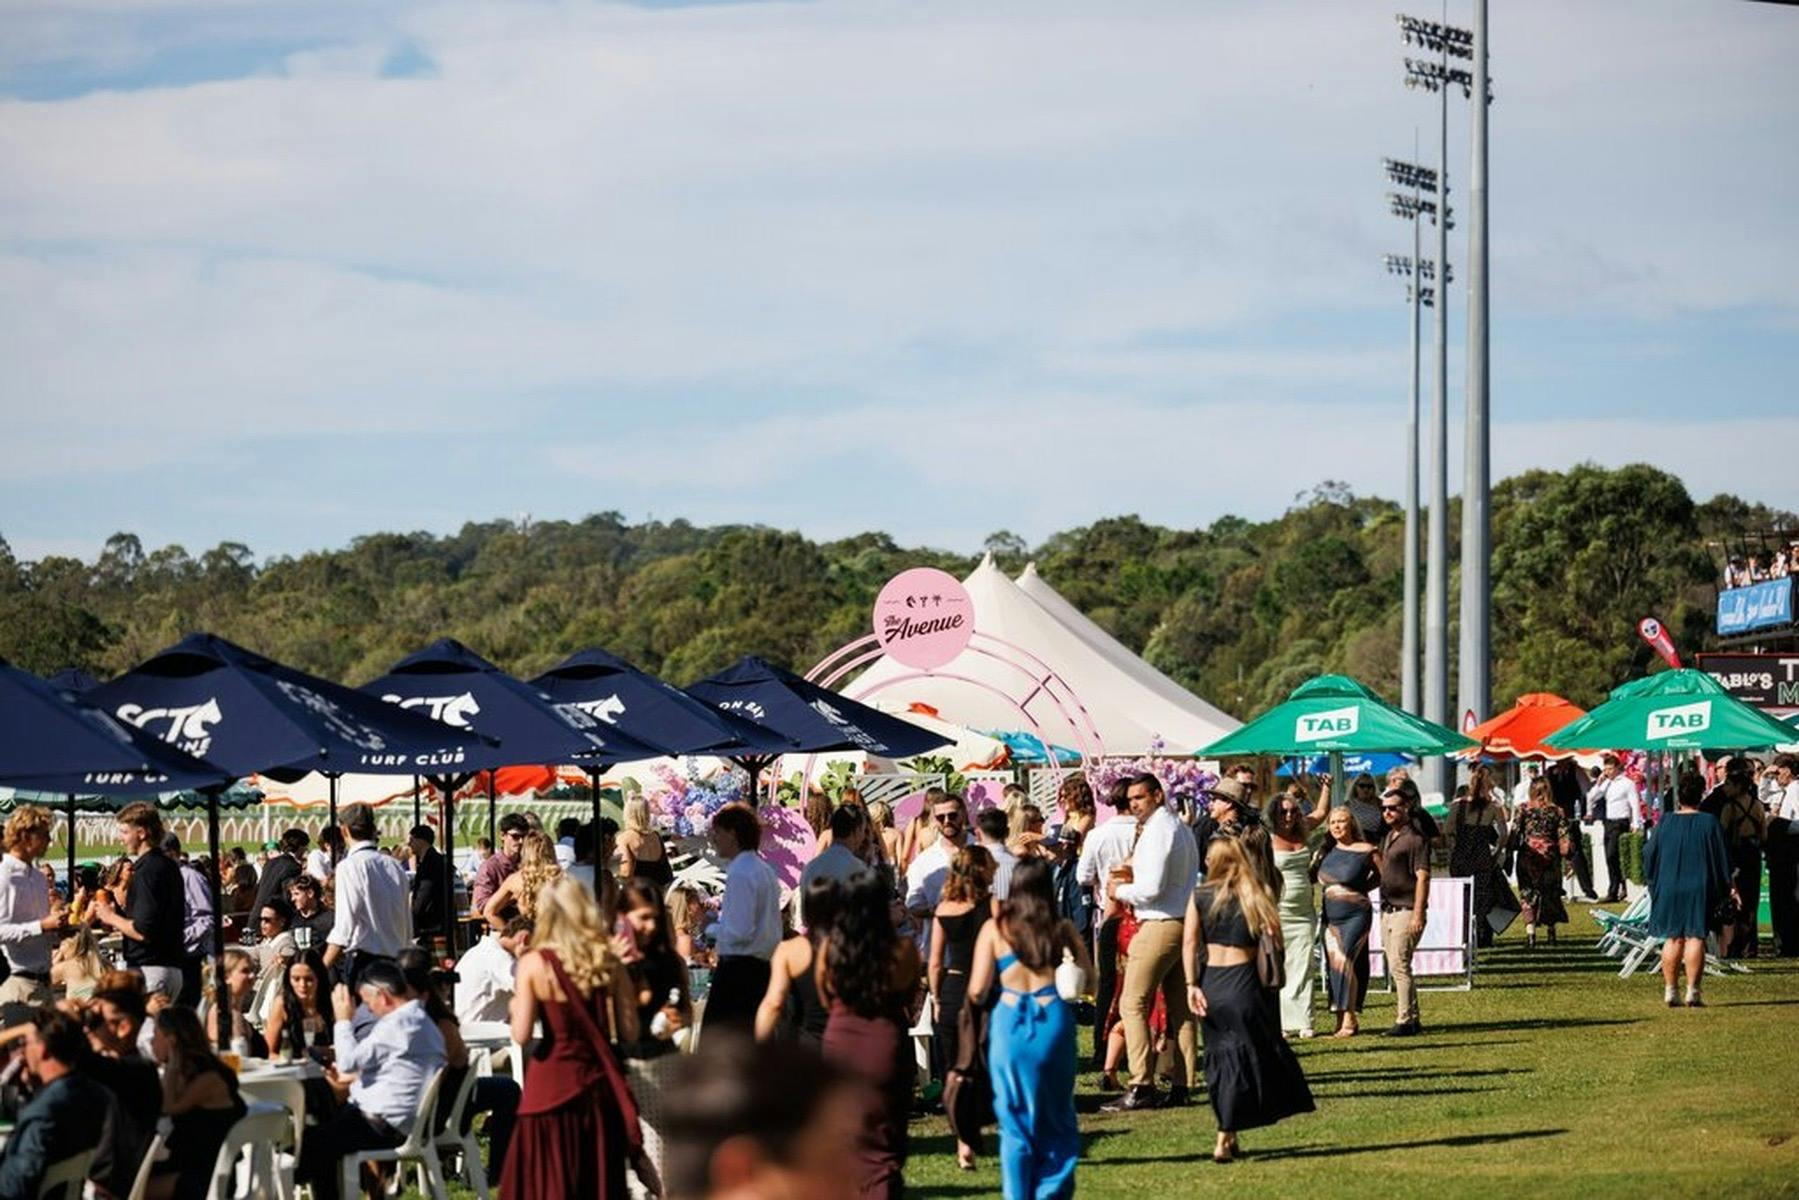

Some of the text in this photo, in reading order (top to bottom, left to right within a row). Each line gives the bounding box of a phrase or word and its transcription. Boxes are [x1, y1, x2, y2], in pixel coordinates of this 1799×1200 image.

[885, 614, 964, 644] Avenue
[1303, 718, 1352, 732] TAB
[1655, 714, 1703, 728] TAB
[415, 753, 465, 766] CLUB
